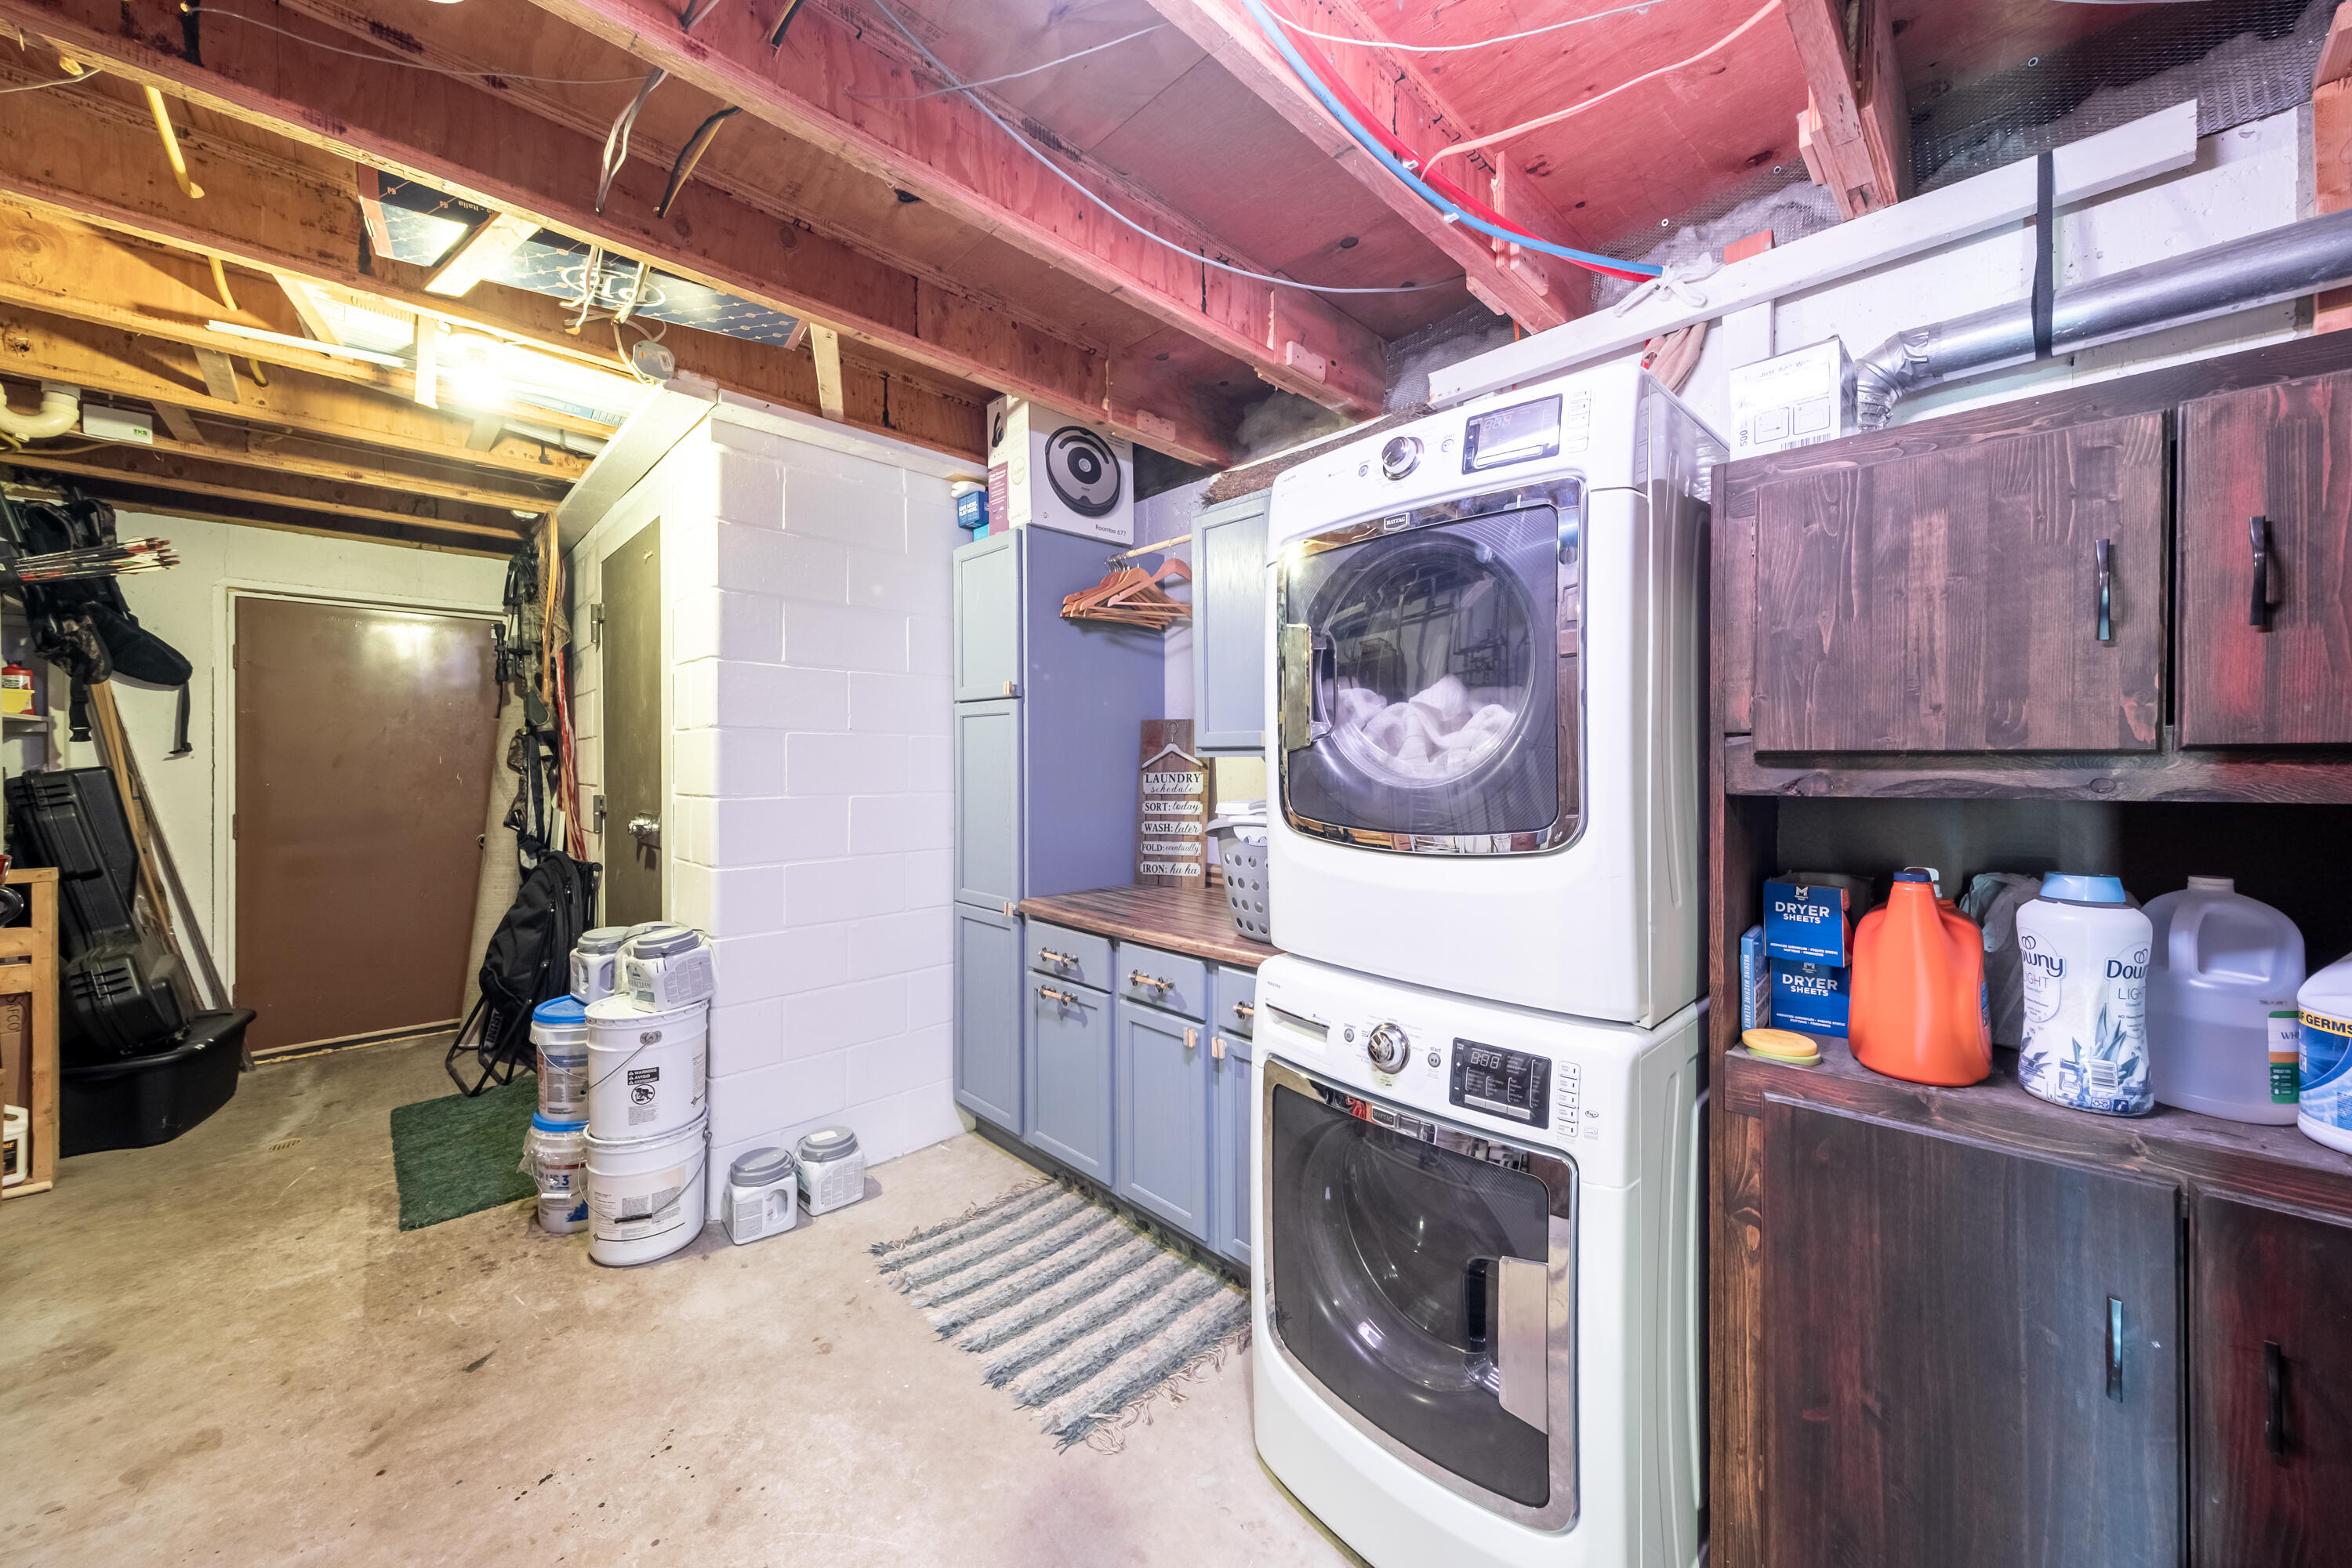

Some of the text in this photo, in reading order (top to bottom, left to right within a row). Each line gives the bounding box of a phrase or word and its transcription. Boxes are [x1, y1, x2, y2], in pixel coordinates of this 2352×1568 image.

[1386, 517, 1406, 526] MAYTAG
[1095, 524, 1116, 535] Roomba
[1145, 773, 1201, 784] LAUNDRY
[1150, 784, 1193, 793] schedule
[1145, 800, 1200, 813] SORT: today
[1145, 822, 1200, 833] WASH: later
[1165, 843, 1200, 855] eventually
[1142, 863, 1198, 875] IRON: ha ha
[1775, 901, 1830, 918] DRYER
[1783, 913, 1821, 924] SHEETS
[1782, 974, 1838, 990] DRYER
[1790, 985, 1829, 996] SHEETS
[2306, 1014, 2352, 1035] GERMS
[1374, 1111, 1393, 1123] MAYTAG
[561, 1174, 570, 1186] 3
